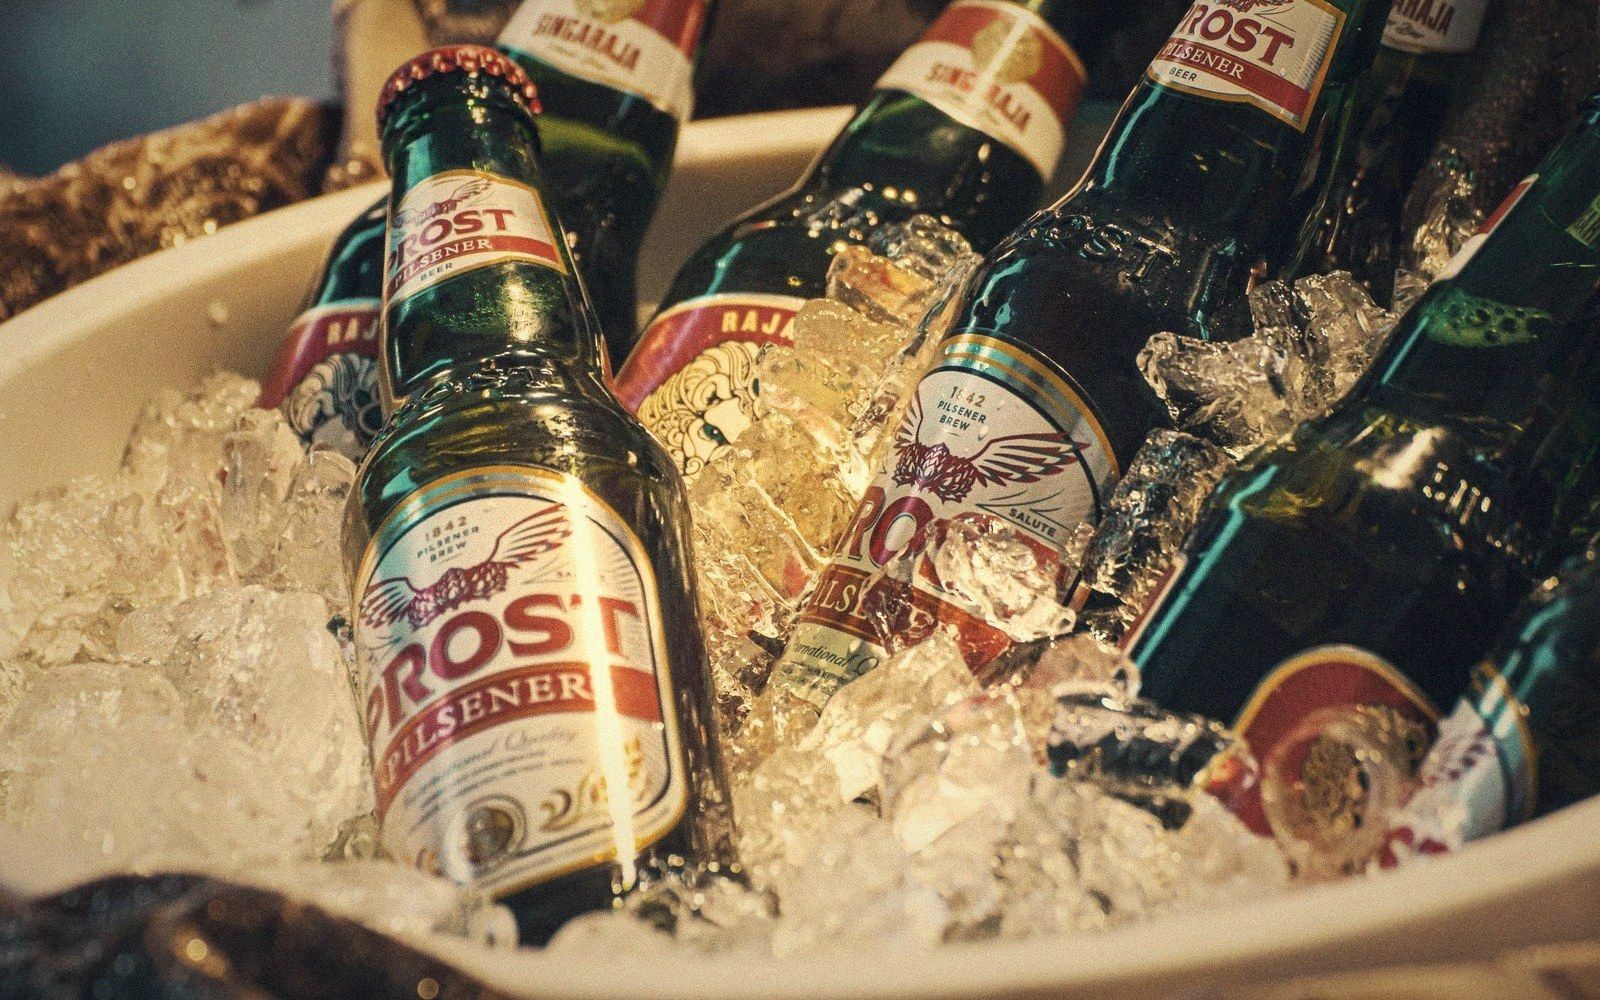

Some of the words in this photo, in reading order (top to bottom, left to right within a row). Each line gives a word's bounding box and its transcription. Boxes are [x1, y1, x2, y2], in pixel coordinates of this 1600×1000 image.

[1162, 42, 1245, 80] PILSENER
[1169, 66, 1197, 82] BEER
[394, 238, 492, 288] PILSENER
[420, 262, 453, 282] BEER
[327, 316, 378, 345] RAJ
[936, 399, 987, 424] PILSENER
[939, 414, 971, 432] BREW
[424, 515, 468, 542] 1842
[1008, 507, 1058, 539] SALUTE
[416, 525, 480, 559] PILSENER
[430, 541, 467, 563] BREW
[384, 671, 595, 789] PILSENER
